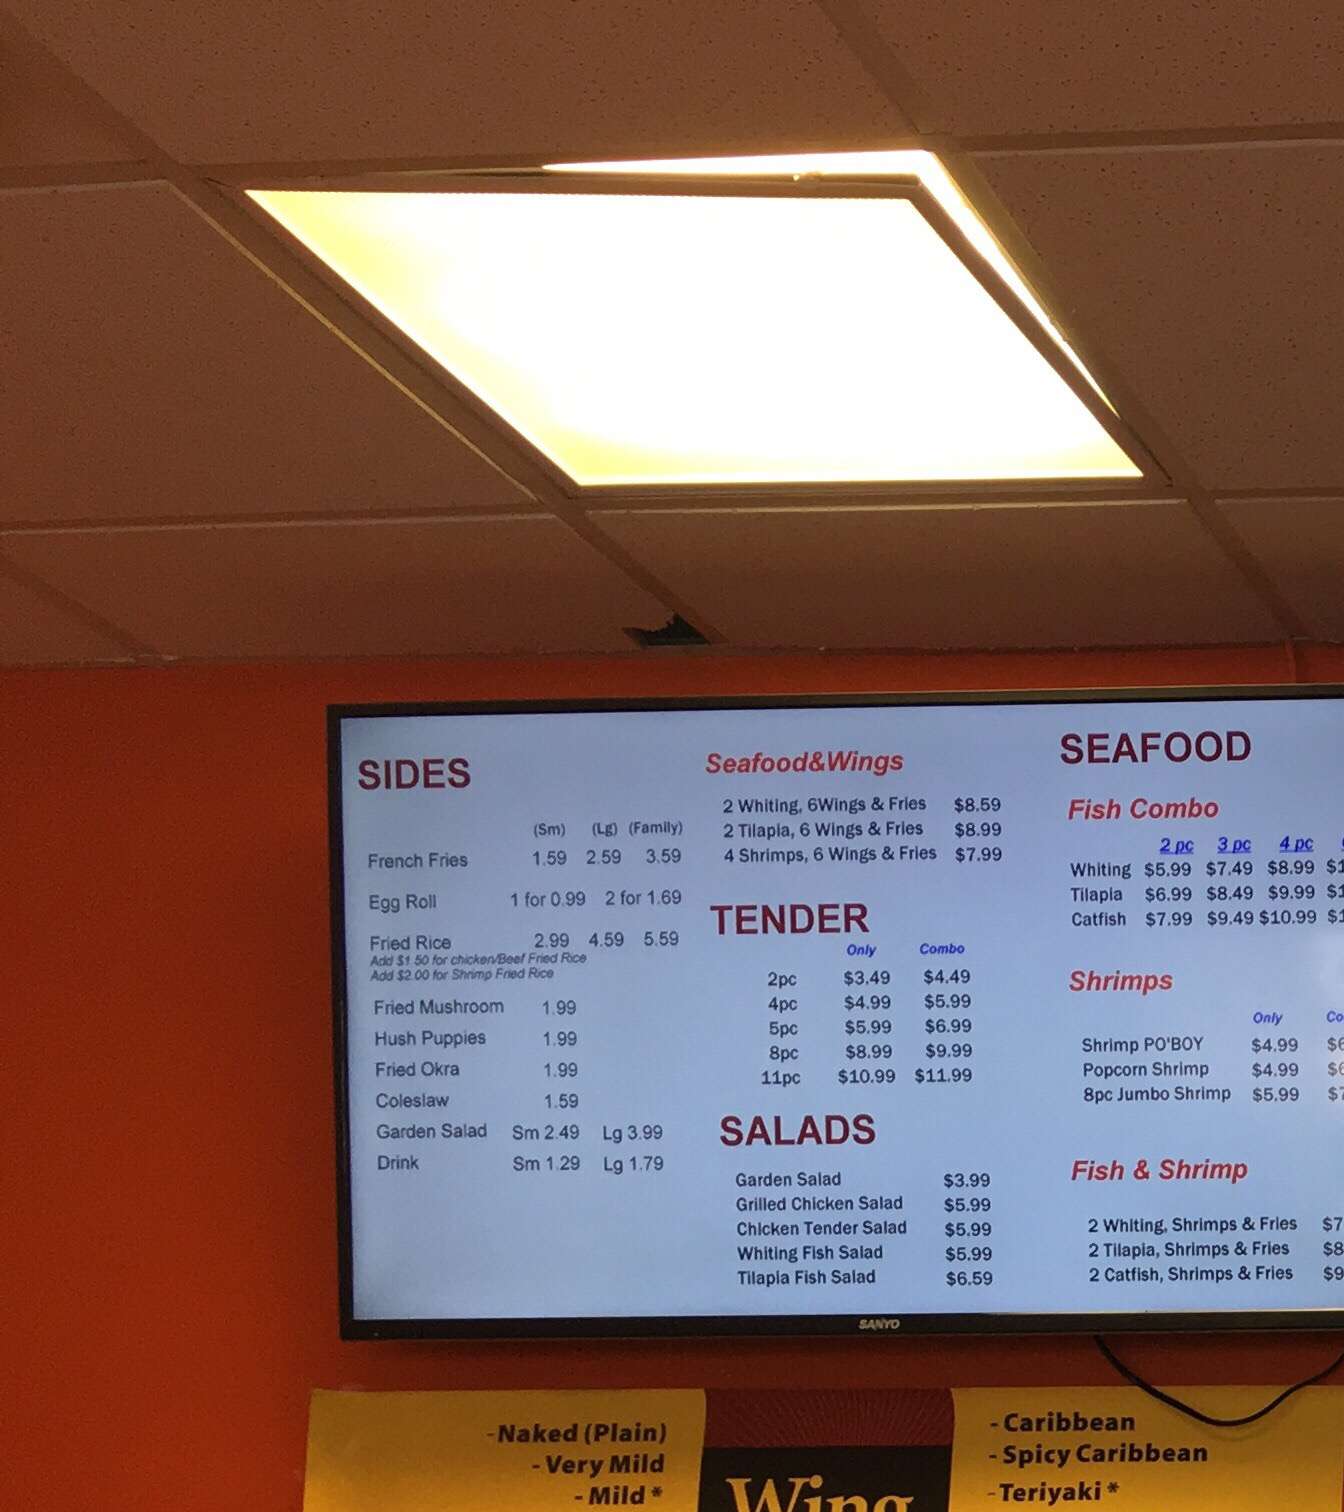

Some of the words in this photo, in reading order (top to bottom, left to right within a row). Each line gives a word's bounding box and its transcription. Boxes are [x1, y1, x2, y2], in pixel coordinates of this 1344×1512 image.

[1061, 731, 1251, 764] SEAFOOD
[359, 758, 470, 790] SIDES
[723, 799, 733, 813] 2
[871, 797, 884, 811] &
[889, 797, 926, 810] Fries
[955, 797, 1001, 813] $8.59
[1069, 799, 1121, 820] Fish
[1130, 797, 1218, 819] Combo
[534, 823, 565, 838] (Sm)
[592, 823, 617, 837] (Lg)
[629, 821, 683, 836] (Family)
[368, 853, 423, 868] French
[429, 852, 468, 867] Fries
[533, 850, 567, 866] 1.59
[587, 849, 621, 864] 2.59
[646, 848, 681, 864] 3.59
[1070, 862, 1131, 879] Whiting
[1145, 862, 1191, 877] $5.99
[1206, 861, 1253, 877] $7.49
[1268, 860, 1314, 876] $8.99
[710, 904, 869, 935] TENDER
[847, 944, 876, 958] Only
[920, 943, 965, 955] Combo
[1069, 970, 1172, 996] Shrimps
[1082, 1038, 1139, 1054] Shrimp
[720, 1114, 875, 1146] SALADS
[378, 1155, 419, 1170] Drink
[1072, 1160, 1124, 1180] Fish
[1133, 1160, 1149, 1180] &
[1159, 1159, 1247, 1184] Shrimp
[736, 1197, 786, 1211] Grilled
[792, 1197, 853, 1211] Chicken
[859, 1196, 902, 1210] Salad
[944, 1198, 991, 1213] $5.99
[859, 1319, 900, 1329] SANYO
[1004, 1411, 1135, 1432] Caribbean
[1004, 1444, 1070, 1468] Spicy
[1076, 1443, 1207, 1462] Caribbean
